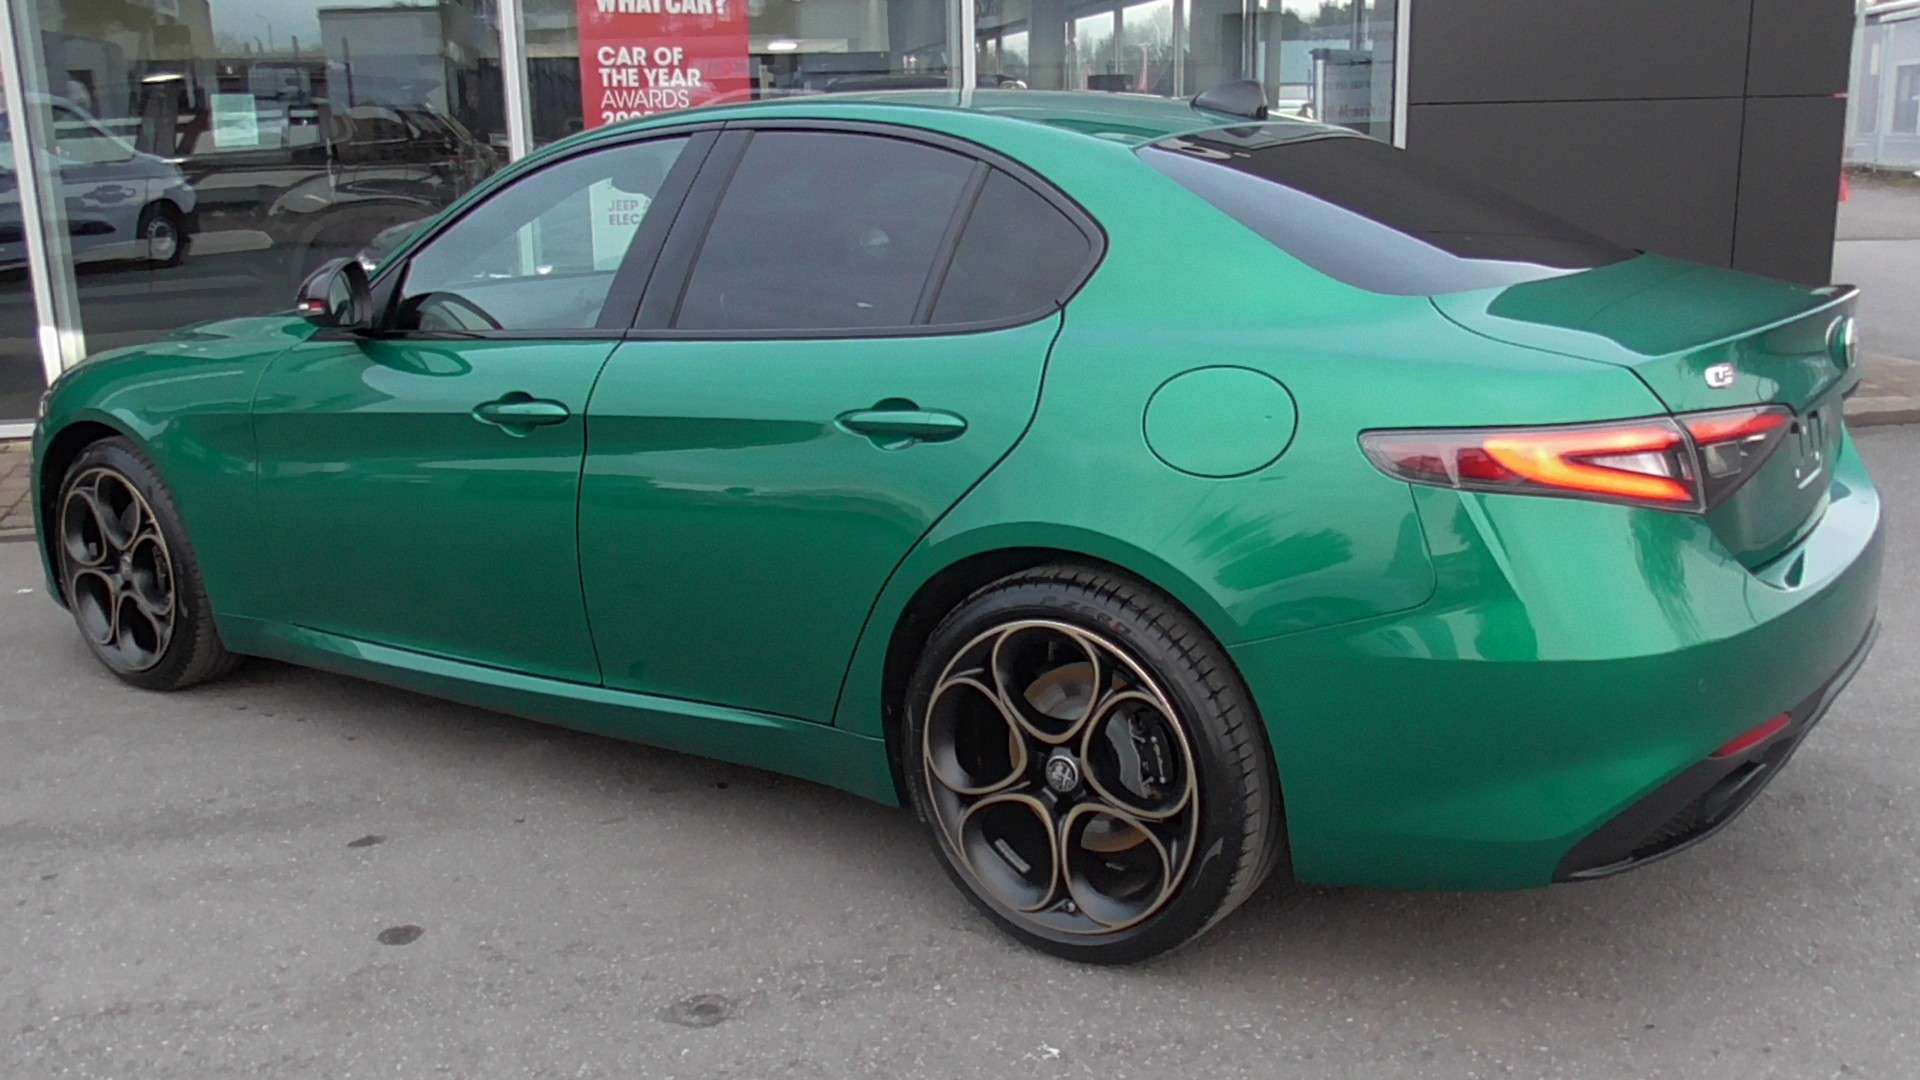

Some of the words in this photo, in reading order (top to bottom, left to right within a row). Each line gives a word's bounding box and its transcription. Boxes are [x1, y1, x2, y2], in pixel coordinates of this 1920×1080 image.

[598, 46, 646, 66] CAR
[653, 47, 684, 66] OF
[599, 67, 639, 87] THE
[644, 68, 701, 87] YEAR
[601, 89, 690, 109] AWARDS
[608, 199, 639, 212] JEEP
